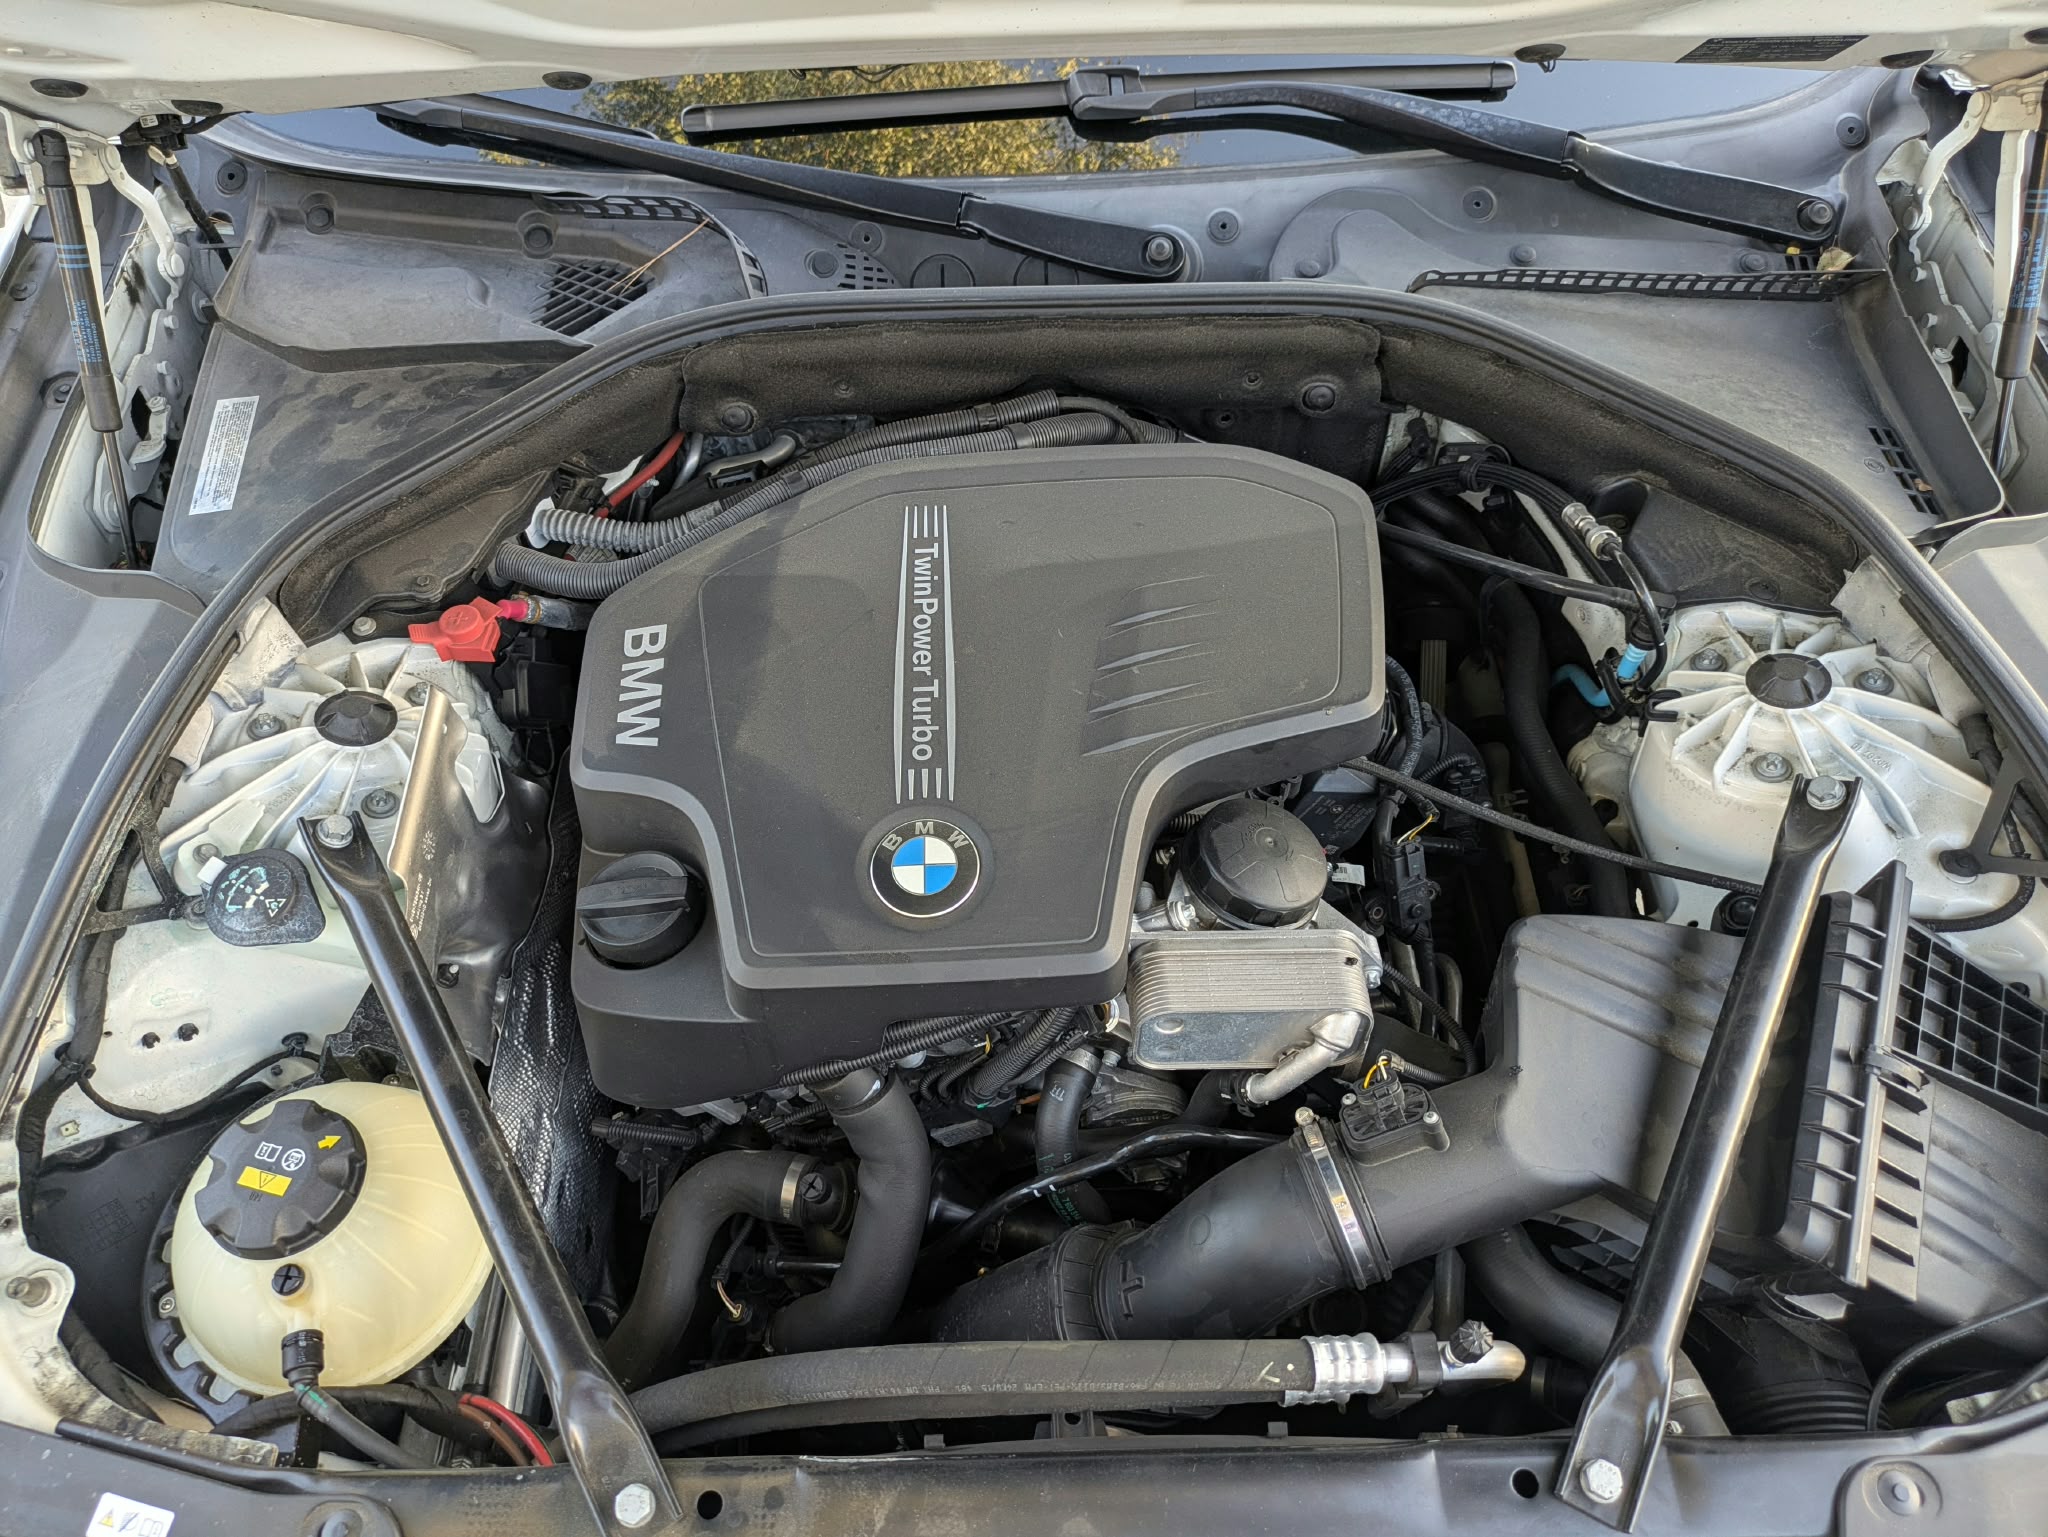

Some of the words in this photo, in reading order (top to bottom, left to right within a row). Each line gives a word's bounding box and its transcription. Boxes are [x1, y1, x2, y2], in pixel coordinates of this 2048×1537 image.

[912, 543, 939, 676] TwinPower
[615, 624, 667, 747] BMW
[911, 679, 940, 761] Turbo
[881, 821, 969, 851] BMW
